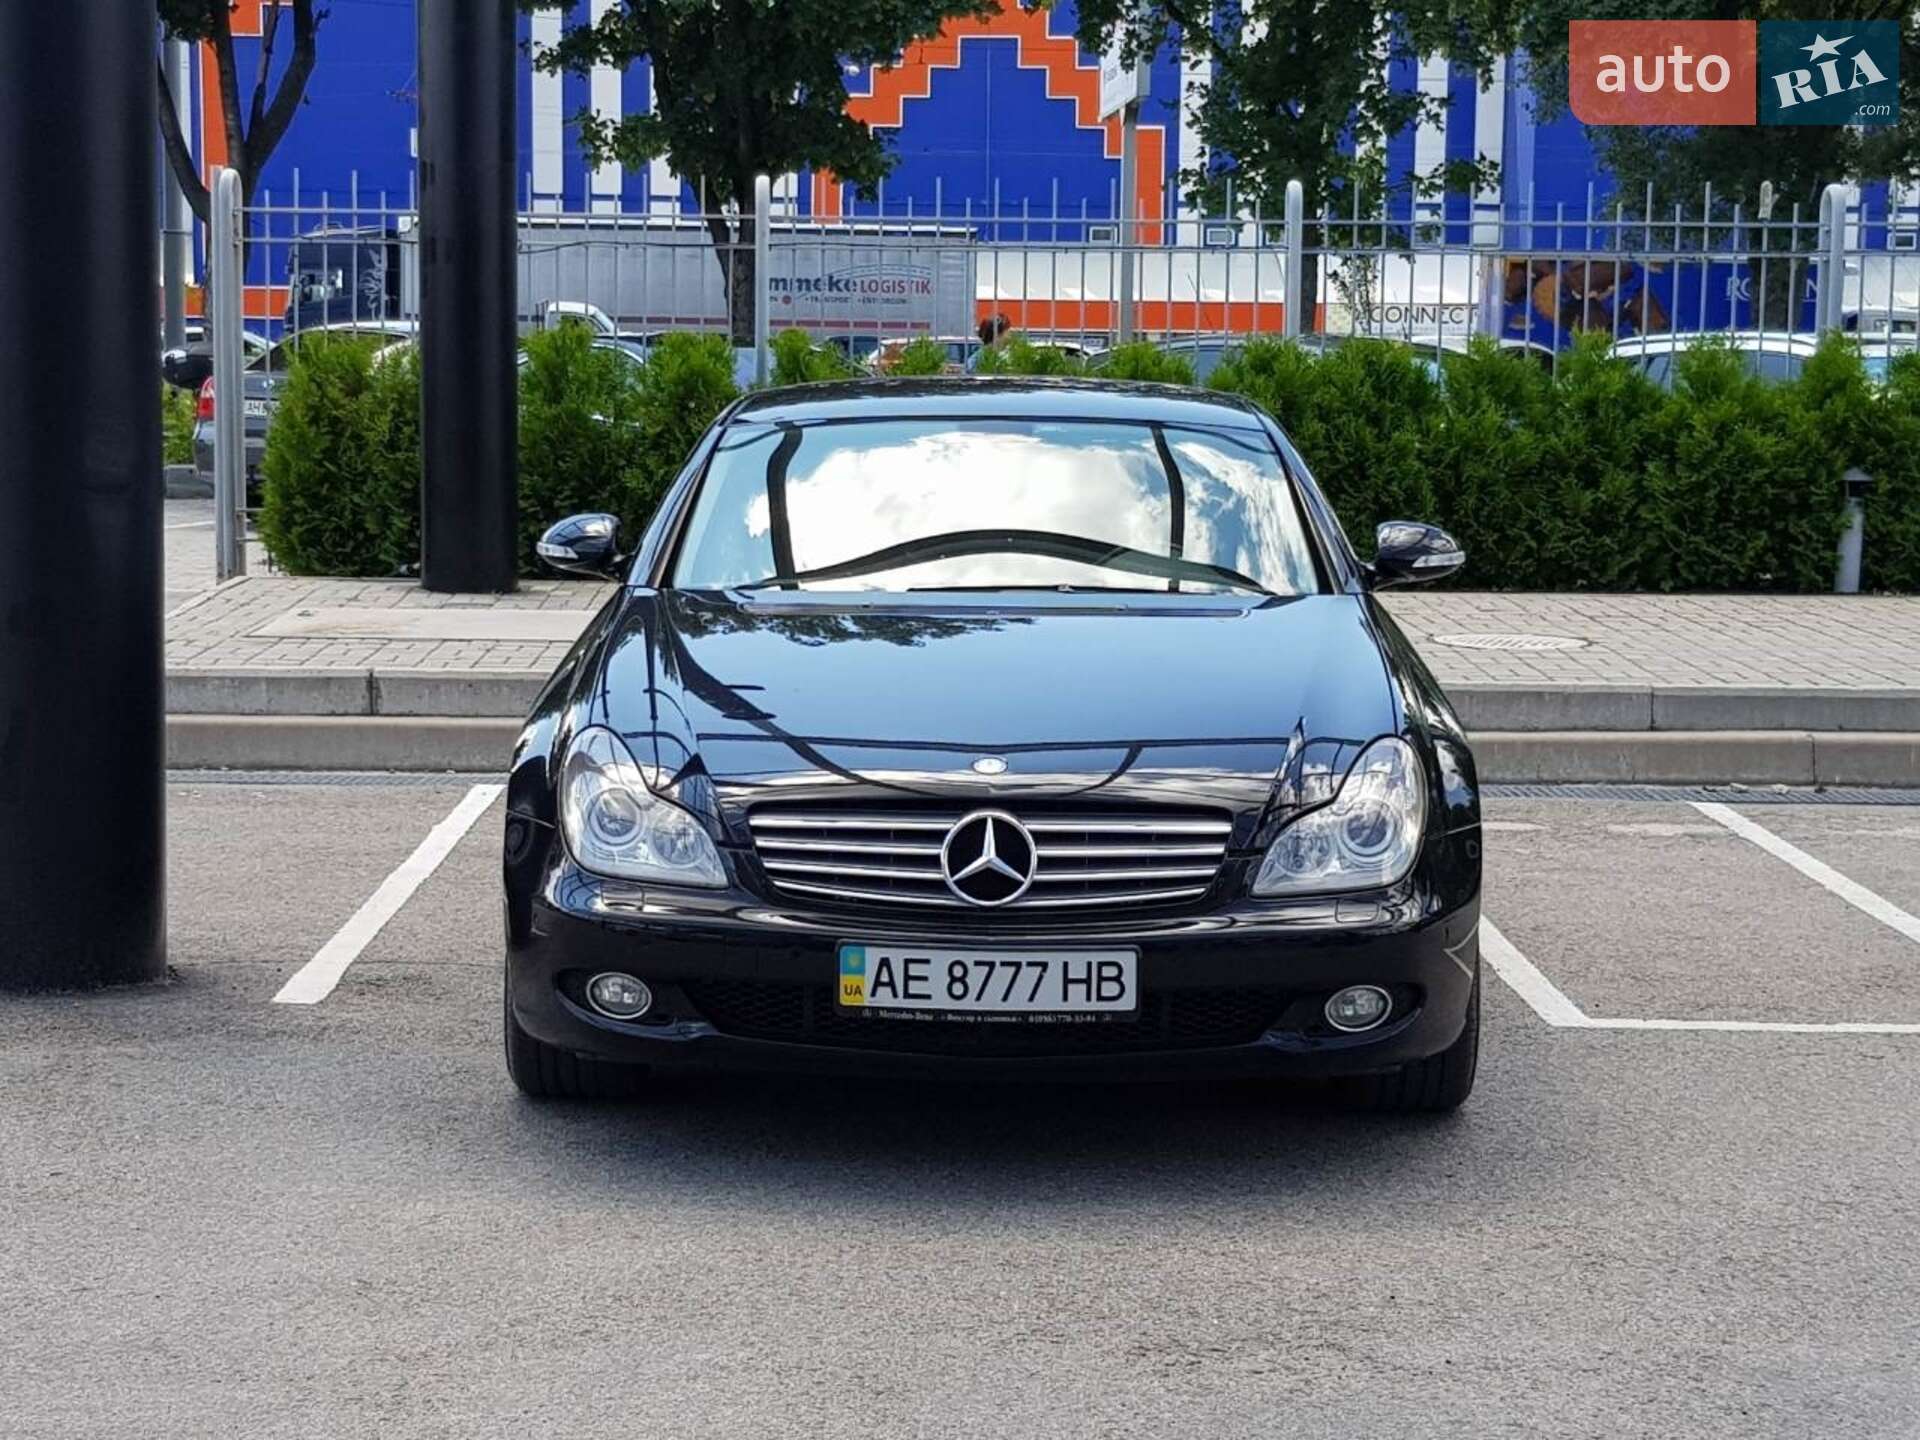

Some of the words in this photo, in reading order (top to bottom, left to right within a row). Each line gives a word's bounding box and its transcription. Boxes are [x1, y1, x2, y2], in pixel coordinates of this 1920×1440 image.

[843, 984, 863, 997] UA
[870, 956, 933, 1000] AE
[946, 959, 1049, 1003] 8777
[1062, 961, 1126, 1004] HB
